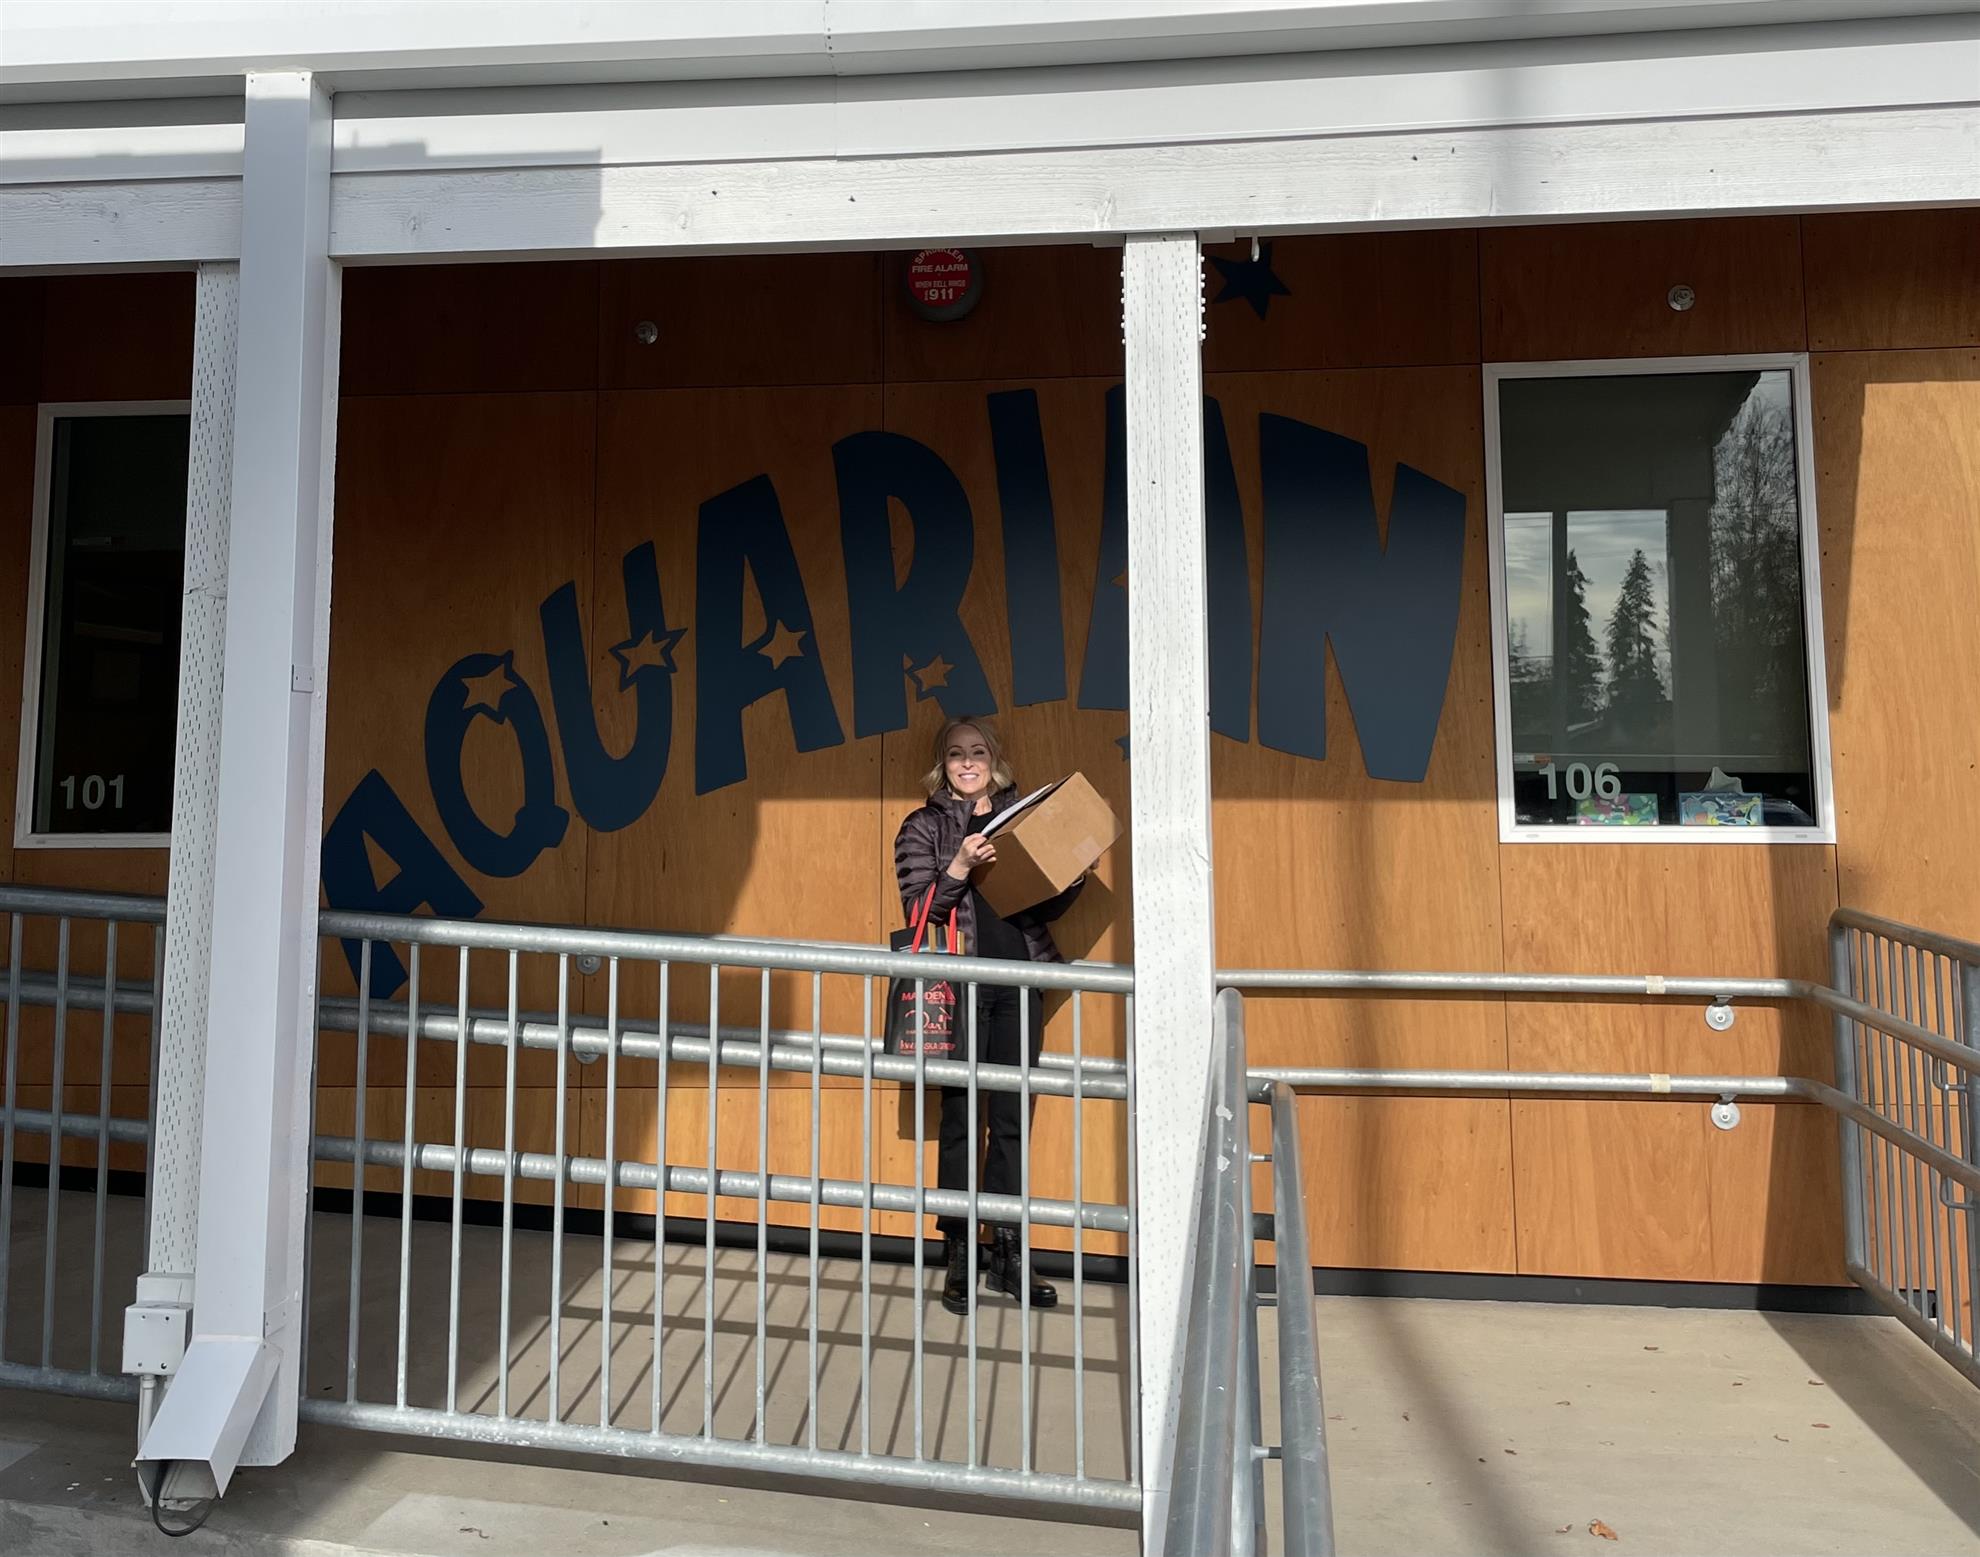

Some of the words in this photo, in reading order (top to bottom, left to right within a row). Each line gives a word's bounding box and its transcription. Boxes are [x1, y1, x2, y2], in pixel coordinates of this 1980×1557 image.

[912, 265, 933, 273] FIRE
[934, 264, 968, 272] ALARM
[929, 288, 953, 300] 911
[320, 382, 1467, 1000] AQUARIAN
[60, 774, 126, 809] 101
[1538, 762, 1622, 800] 106
[901, 991, 946, 1001] MADEN
